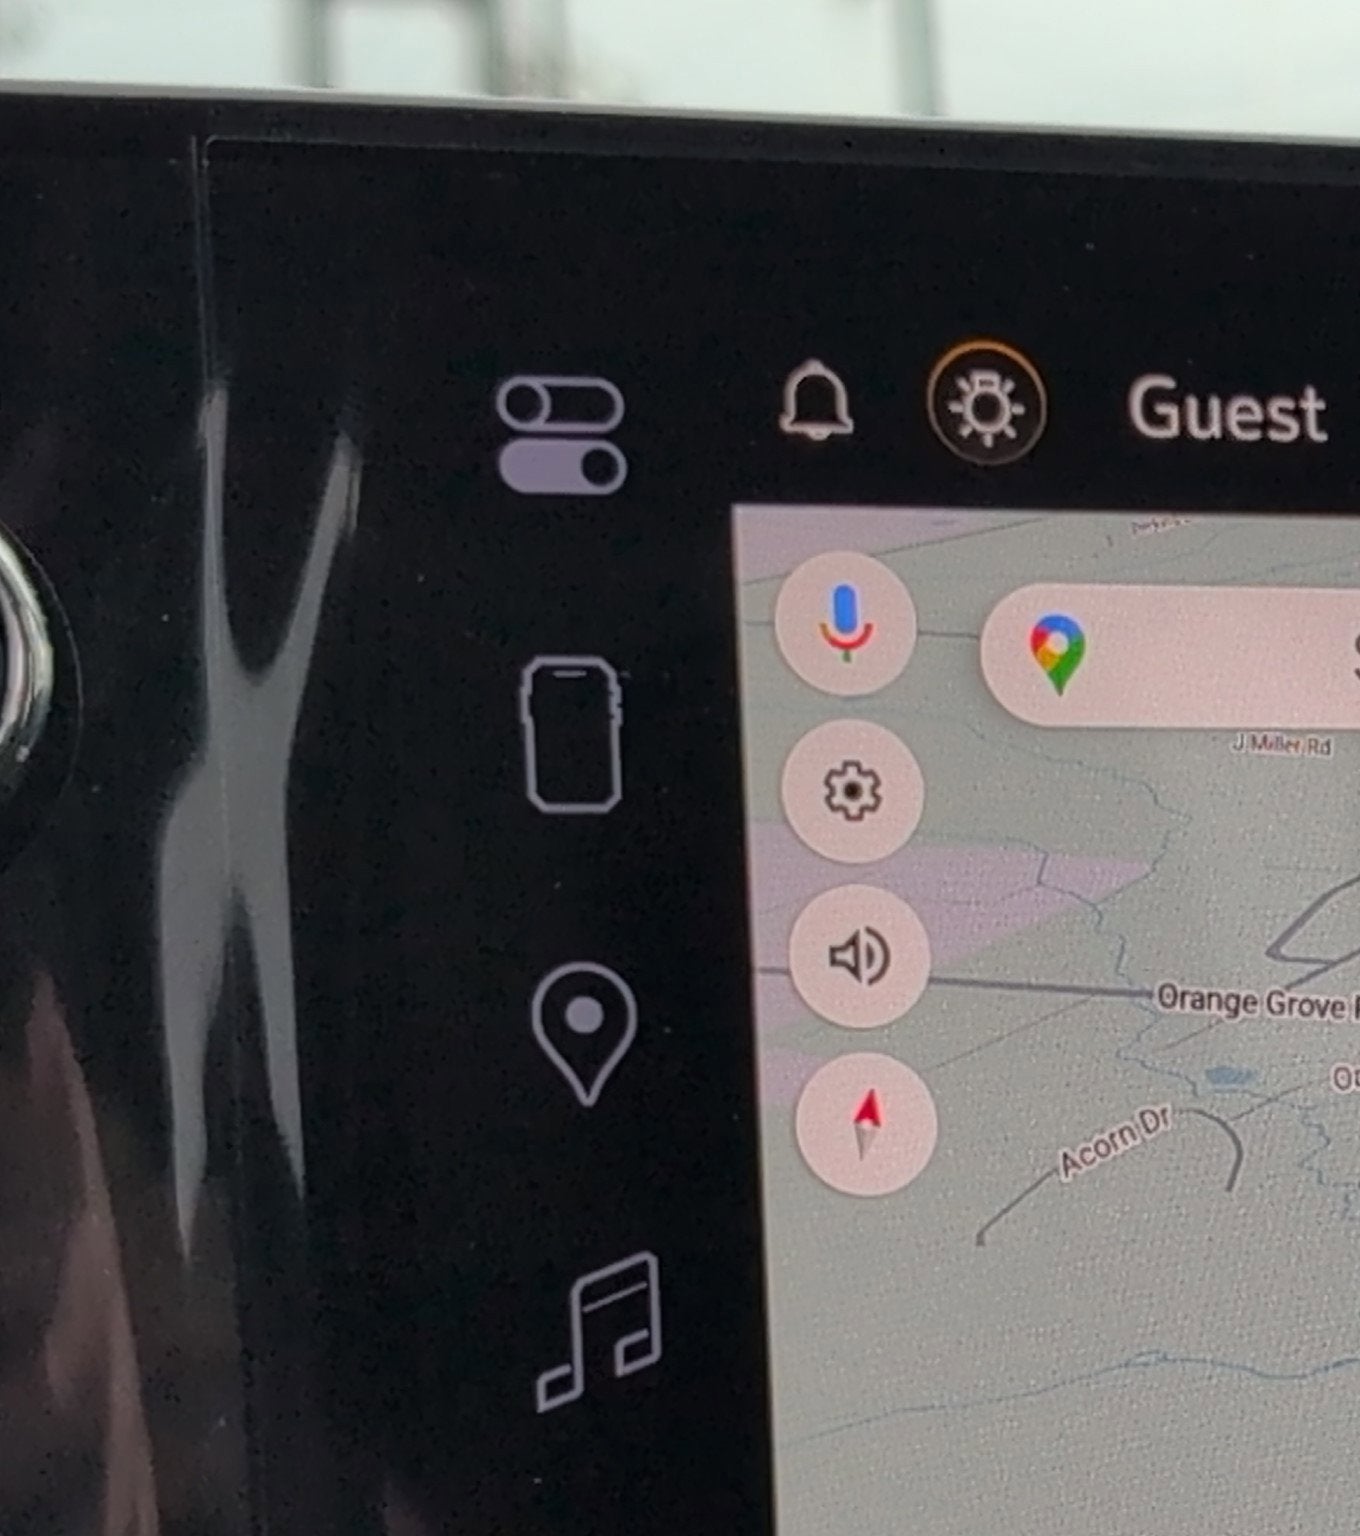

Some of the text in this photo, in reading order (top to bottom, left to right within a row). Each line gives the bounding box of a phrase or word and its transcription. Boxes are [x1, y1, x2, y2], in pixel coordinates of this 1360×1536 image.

[1127, 373, 1328, 443] Guest
[1308, 738, 1332, 755] Rd
[1157, 983, 1258, 1018] Orange
[1265, 989, 1346, 1018] Grove
[1060, 1107, 1172, 1179] Acorn Dr
